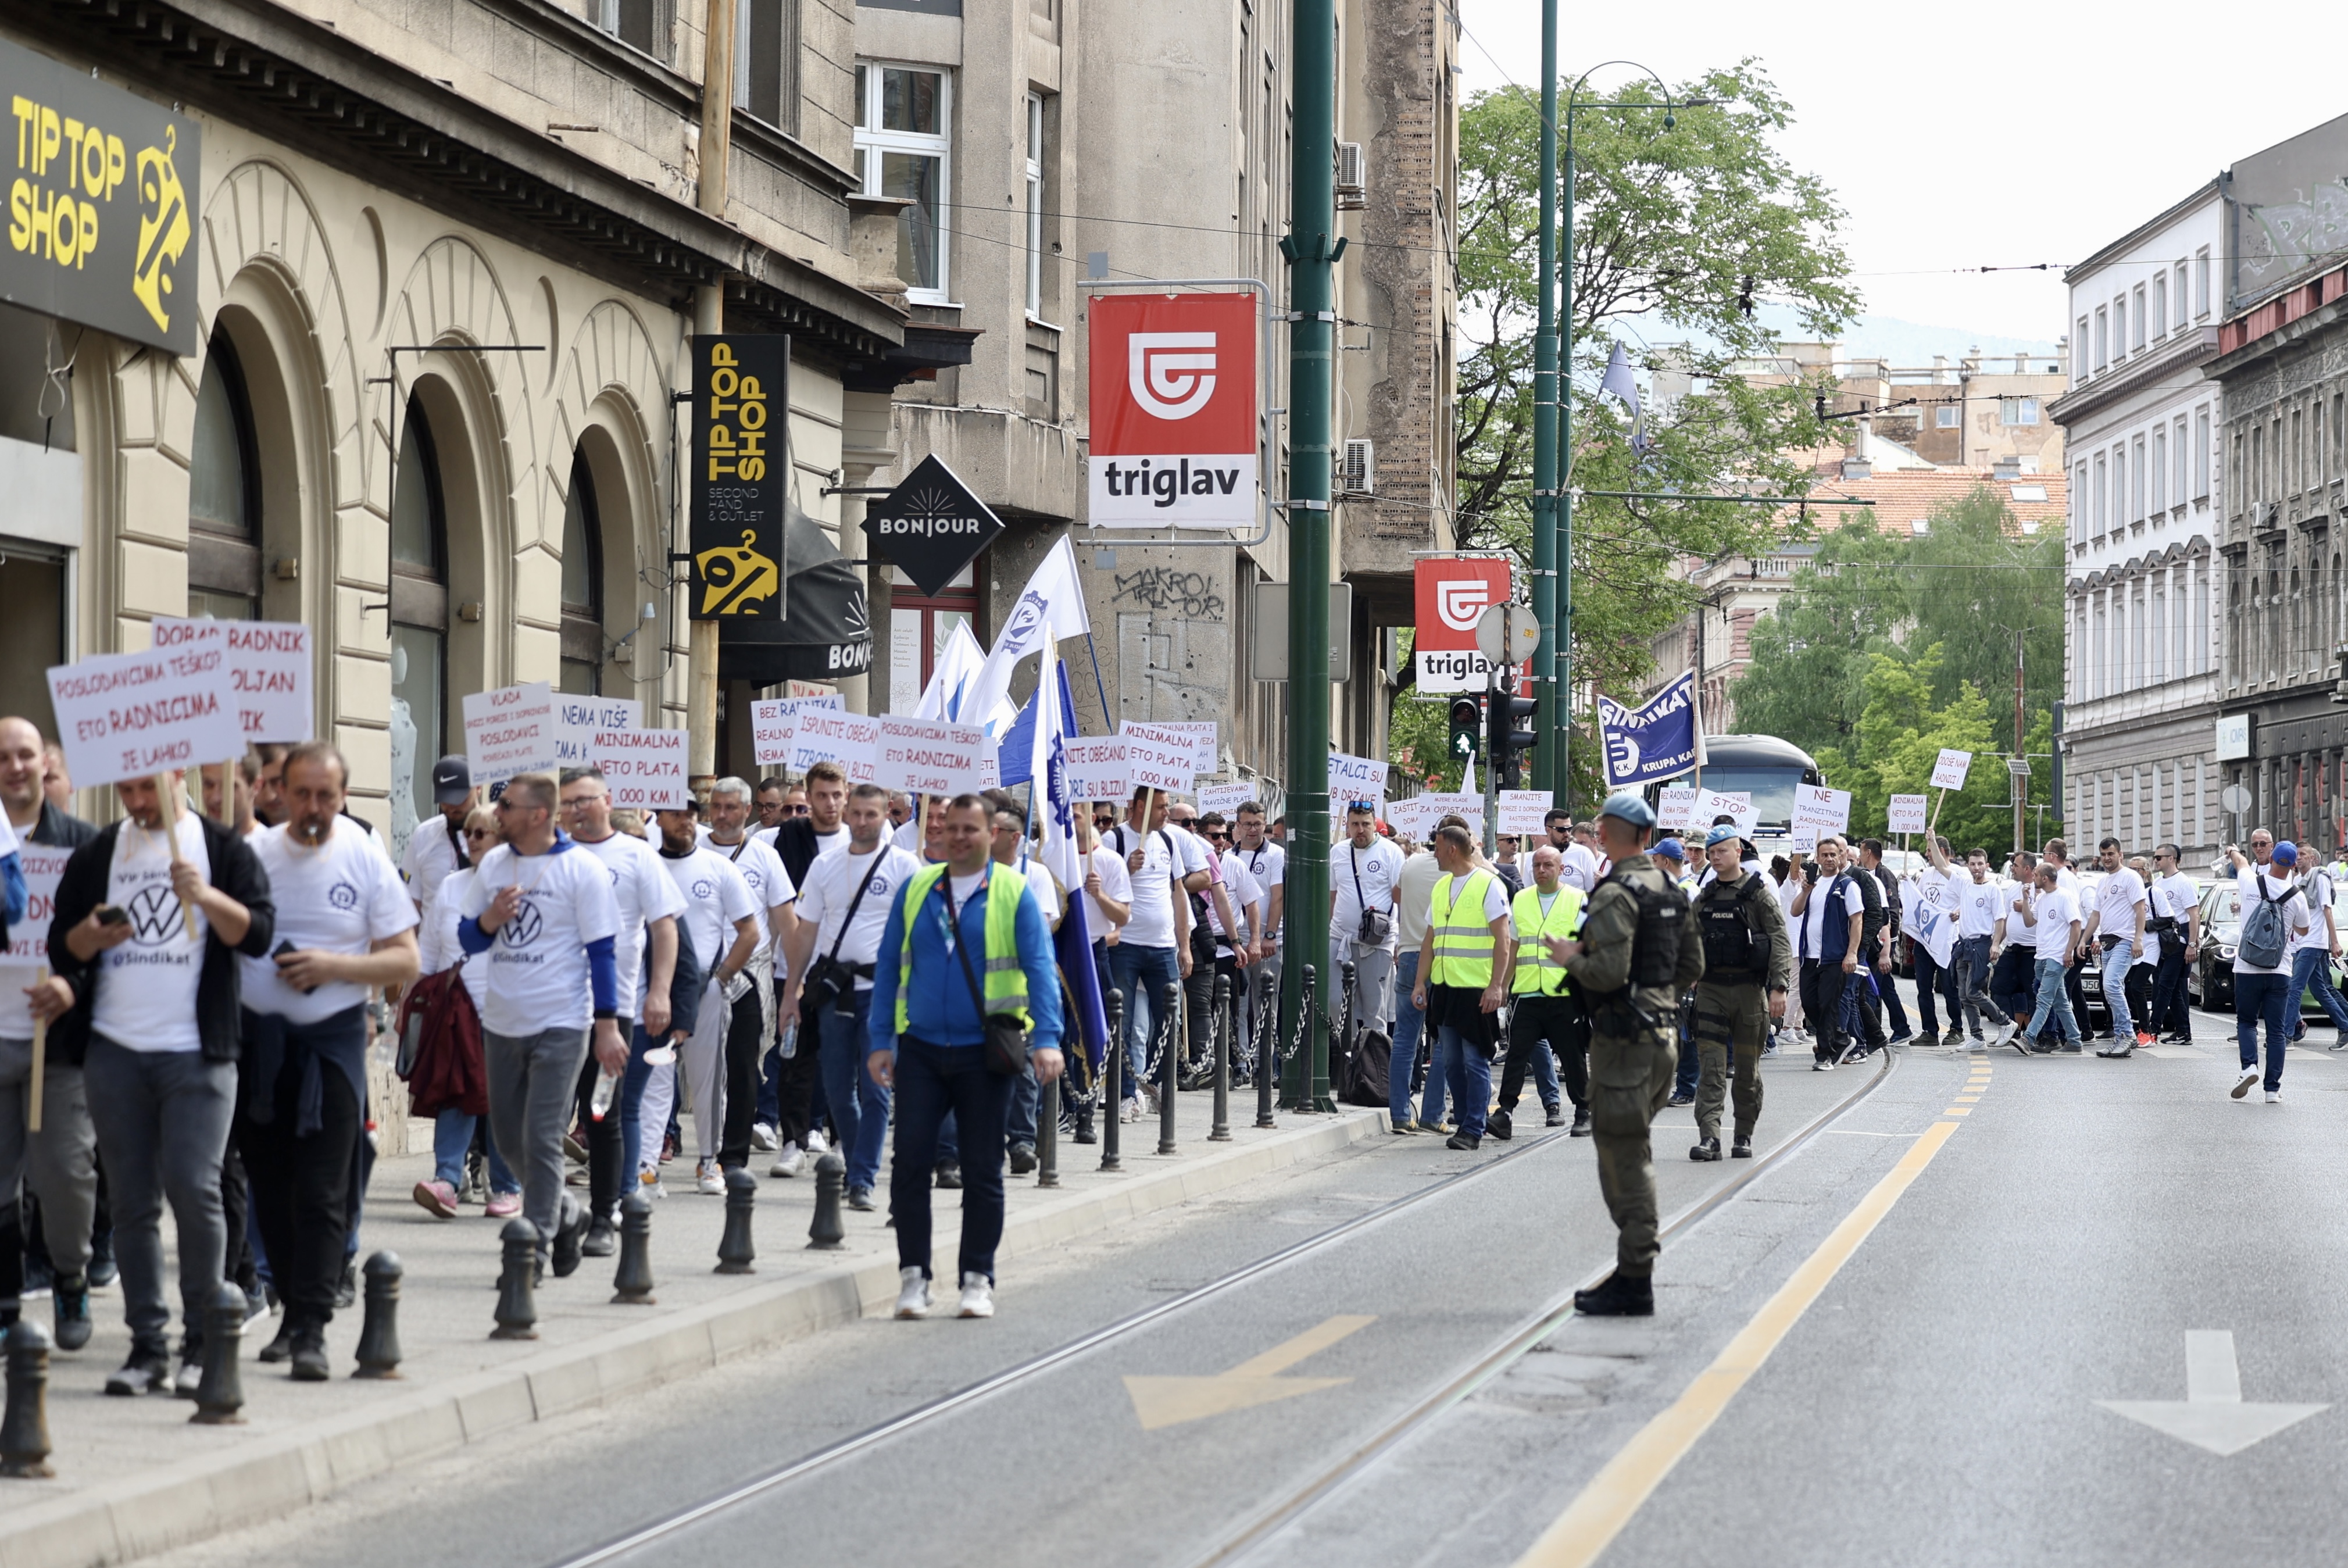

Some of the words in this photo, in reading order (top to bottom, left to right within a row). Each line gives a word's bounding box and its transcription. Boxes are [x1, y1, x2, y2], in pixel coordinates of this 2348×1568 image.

[12, 95, 60, 177] TIP
[65, 119, 126, 202] TOP
[9, 178, 98, 270] SHOP
[711, 342, 738, 418] TOP
[738, 376, 766, 481] SHOP
[709, 425, 736, 481] TIP
[1105, 458, 1240, 508] triglav
[709, 488, 759, 498] SECOND
[709, 499, 742, 509] HAND
[709, 511, 716, 521] &
[719, 511, 764, 521] OUTLET
[228, 628, 304, 652] RADNIK
[56, 663, 165, 699] POSLODAVCIMA
[169, 649, 221, 676] TEŠKO?
[1425, 652, 1500, 680] triglav
[491, 691, 521, 706] VLADA
[76, 718, 106, 742] ETO
[109, 692, 220, 733] RADNICIMA
[562, 705, 595, 726] NEMA
[601, 704, 628, 728] VIŠE
[760, 707, 777, 719] BEZ
[480, 724, 539, 746] POSLODAVCI
[756, 728, 794, 741] REALNO
[800, 716, 845, 739] ISPUNITE
[846, 722, 879, 744] OBEĆAN
[881, 722, 946, 741] POSLODAVCIMA
[950, 728, 982, 745] TEŠKO?
[1125, 726, 1193, 749] MINIMALNA
[594, 733, 680, 748] MINIMALNA
[122, 749, 139, 771] JE
[758, 749, 785, 761] NEMA
[886, 749, 903, 762] ETO
[906, 748, 971, 770] RADNICIMA
[1088, 741, 1126, 763] OBEĆANO
[593, 760, 631, 774] NETO
[637, 761, 680, 776] PLATA
[1156, 752, 1190, 770] PLATA
[1616, 763, 1632, 772] K.K.
[1642, 757, 1677, 773] KRUPA
[1938, 755, 1955, 767] ODOŠE
[1955, 759, 1967, 769] NAM
[905, 775, 916, 787] JE
[918, 776, 949, 791] LAHKO!
[1131, 769, 1160, 784] 1.000
[1164, 776, 1179, 790] KM
[1370, 770, 1384, 783] SU
[1935, 773, 1956, 784] RADNICI
[1087, 782, 1098, 796] SU
[1101, 779, 1127, 796] BLIZU!
[1204, 785, 1248, 795] ZAHTIJEVAMO
[1670, 790, 1694, 800] RADNIKA
[1814, 789, 1832, 802] NE
[651, 790, 670, 803] KM
[1202, 796, 1231, 806] PRAVIČNE
[1434, 806, 1482, 815] O(P)STANAK
[1711, 796, 1746, 815] STOP
[1799, 805, 1843, 818] TRANZITNIM
[1795, 838, 1813, 850] IZBORI
